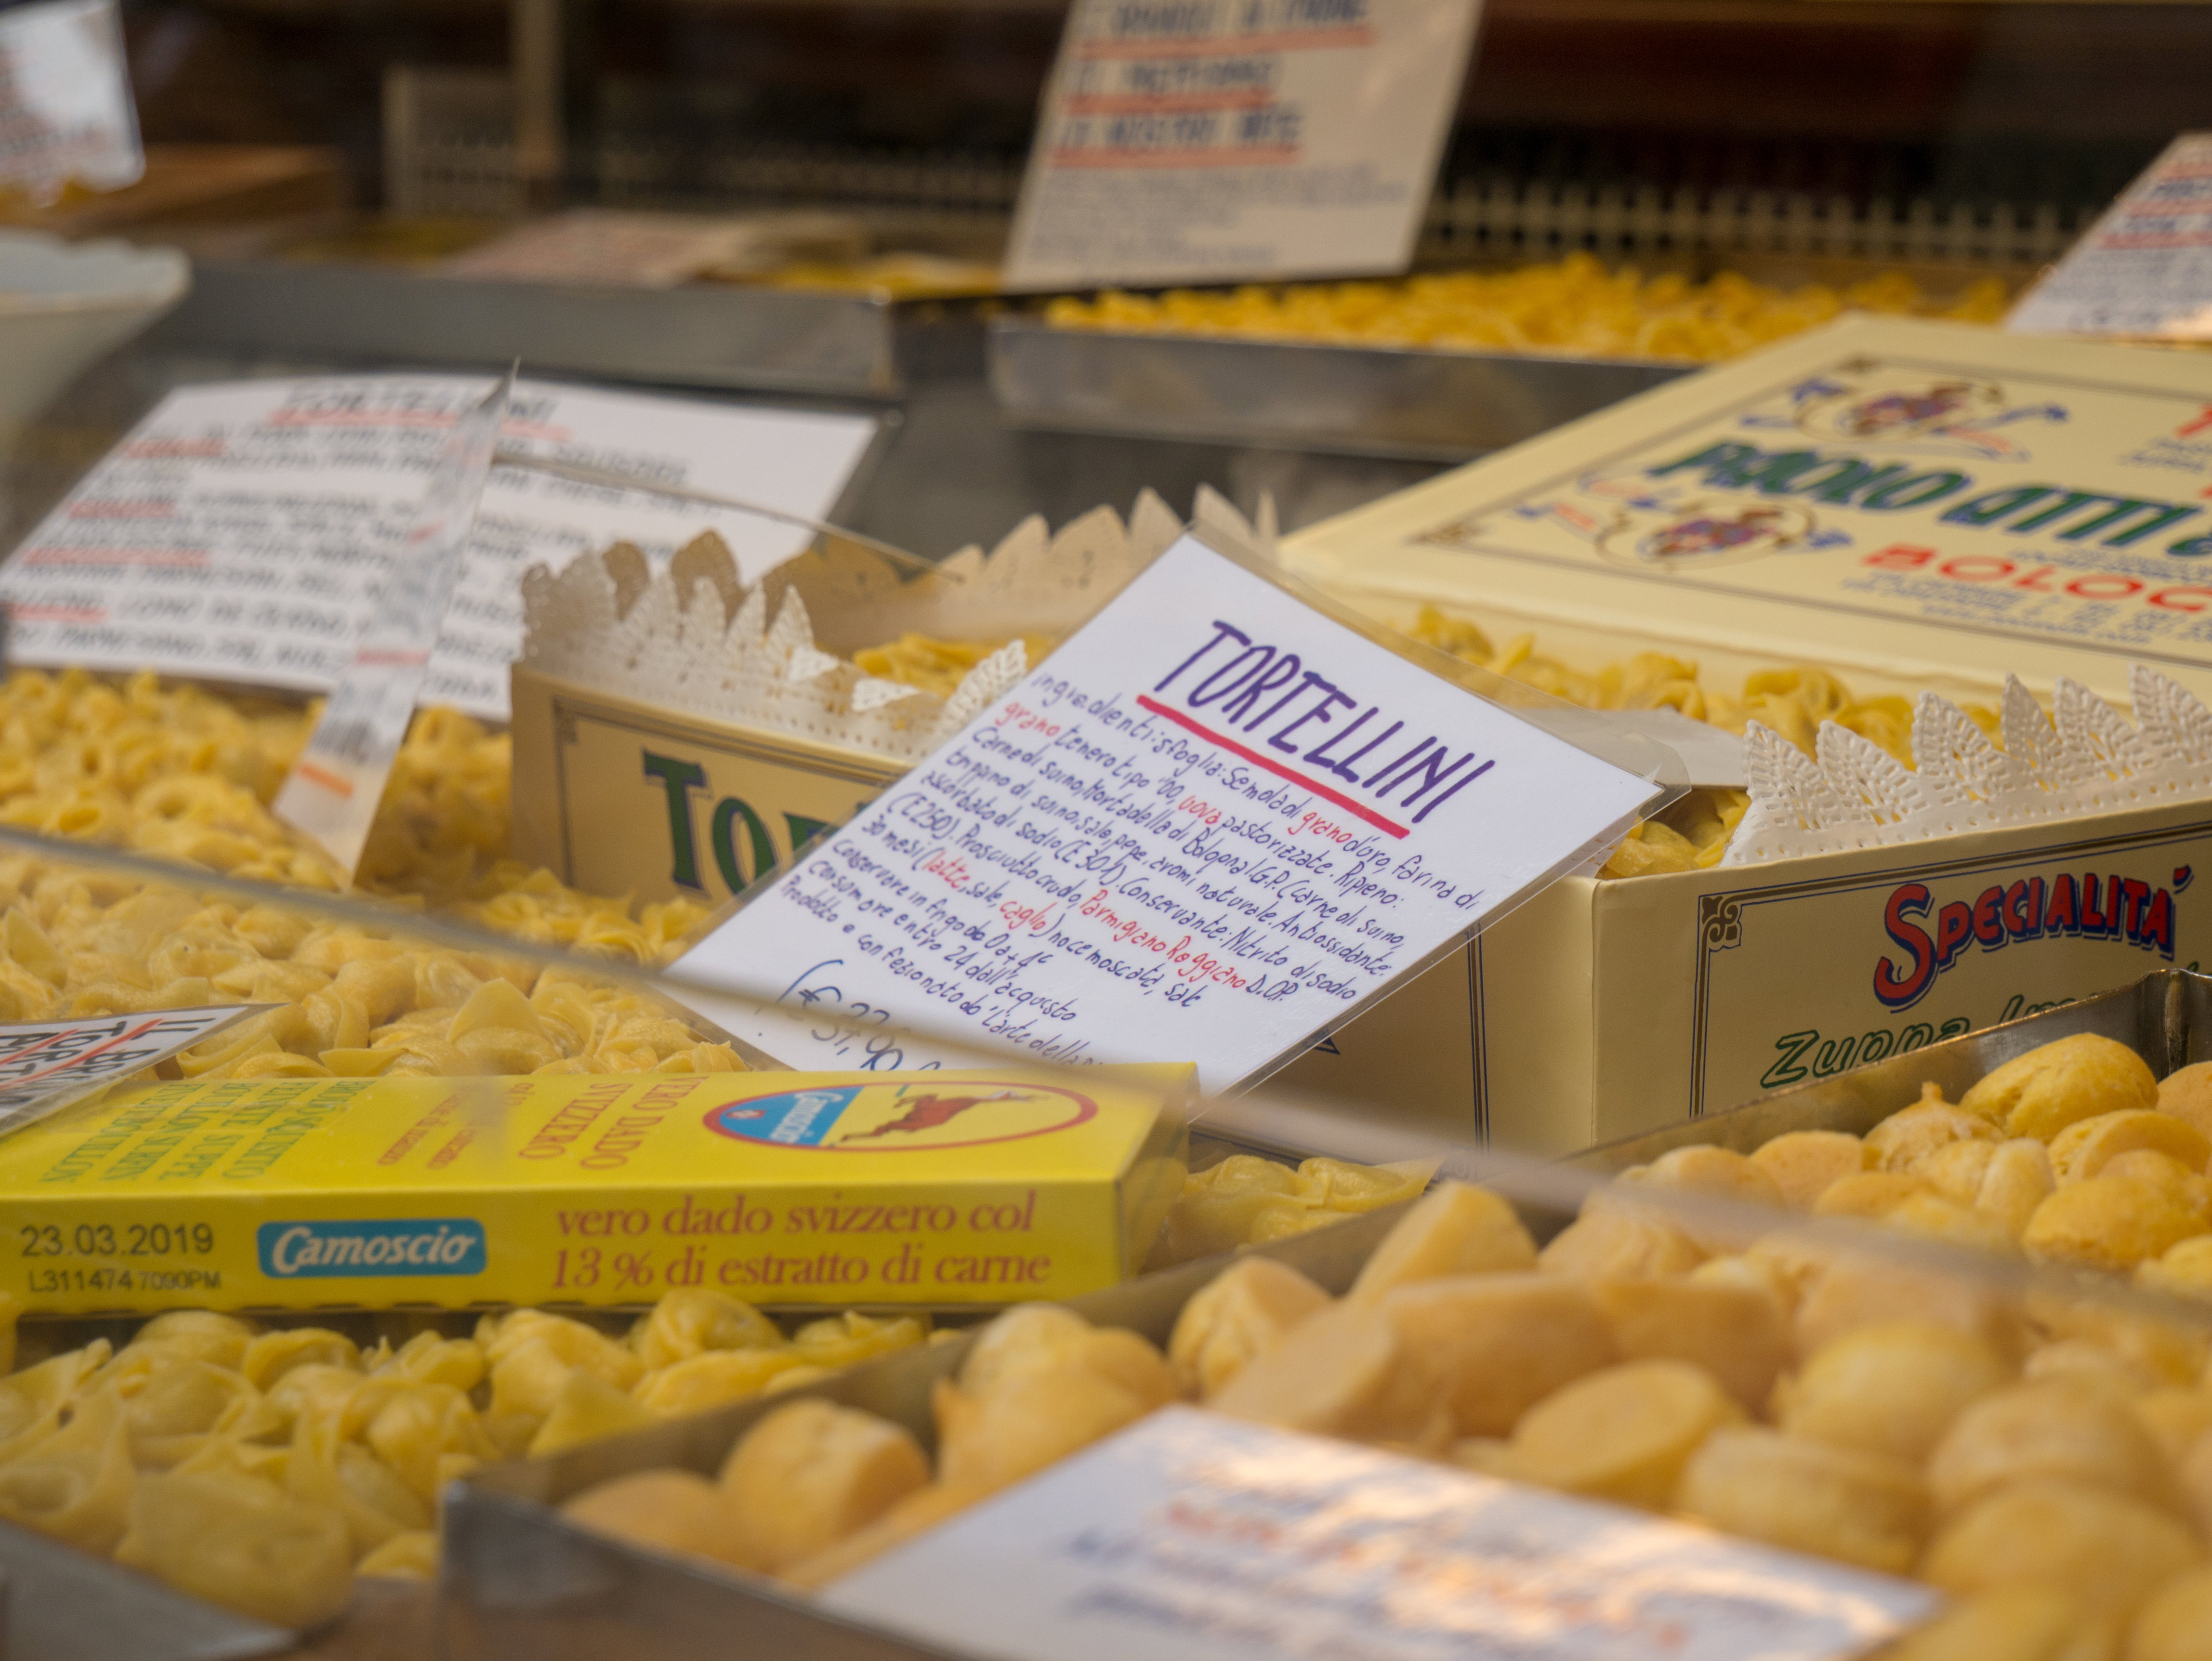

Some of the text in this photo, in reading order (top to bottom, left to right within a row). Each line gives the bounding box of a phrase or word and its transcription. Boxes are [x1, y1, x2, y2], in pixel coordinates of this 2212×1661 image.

[1937, 486, 2204, 548] ATTI
[1152, 619, 1496, 824] TORTELLINI
[994, 702, 1061, 750] grano
[1053, 725, 1117, 767] tenero
[1111, 755, 1150, 790] tipo
[1177, 795, 1222, 825] uova
[1333, 860, 1404, 908] Ripieno:
[1009, 779, 1035, 799] di
[1148, 856, 1196, 886] aromi
[1014, 821, 1062, 848] sodio
[1287, 812, 1353, 844] grano
[1391, 854, 1457, 898] farina
[1453, 889, 1484, 910] di
[861, 813, 887, 836] 30
[882, 830, 931, 857] mesi
[1047, 930, 1093, 955] noce
[908, 891, 928, 907] in
[925, 897, 966, 931] frigo
[955, 822, 1041, 879] Prosciutto
[1034, 874, 1087, 909] crudo,
[1079, 888, 1167, 952] Parmigiano
[1166, 935, 1247, 989] Reggiano
[1167, 819, 1197, 842] di
[1335, 905, 1367, 926] di
[1356, 919, 1405, 950] suino,
[842, 923, 856, 934] e
[893, 913, 947, 950] entro
[943, 945, 979, 970] 24
[1220, 926, 1289, 966] Nitrito
[1290, 960, 1321, 979] di
[1305, 973, 1356, 1000] sodio
[519, 1083, 633, 1160] SVIZZERO
[579, 1076, 709, 1170] VERO DADO
[20, 1223, 214, 1257] 23.03.2019
[556, 1189, 1038, 1237] vero dado svizzero col
[273, 1226, 476, 1276] Camoscio
[552, 1242, 1052, 1291] 13 % di estratto di carne
